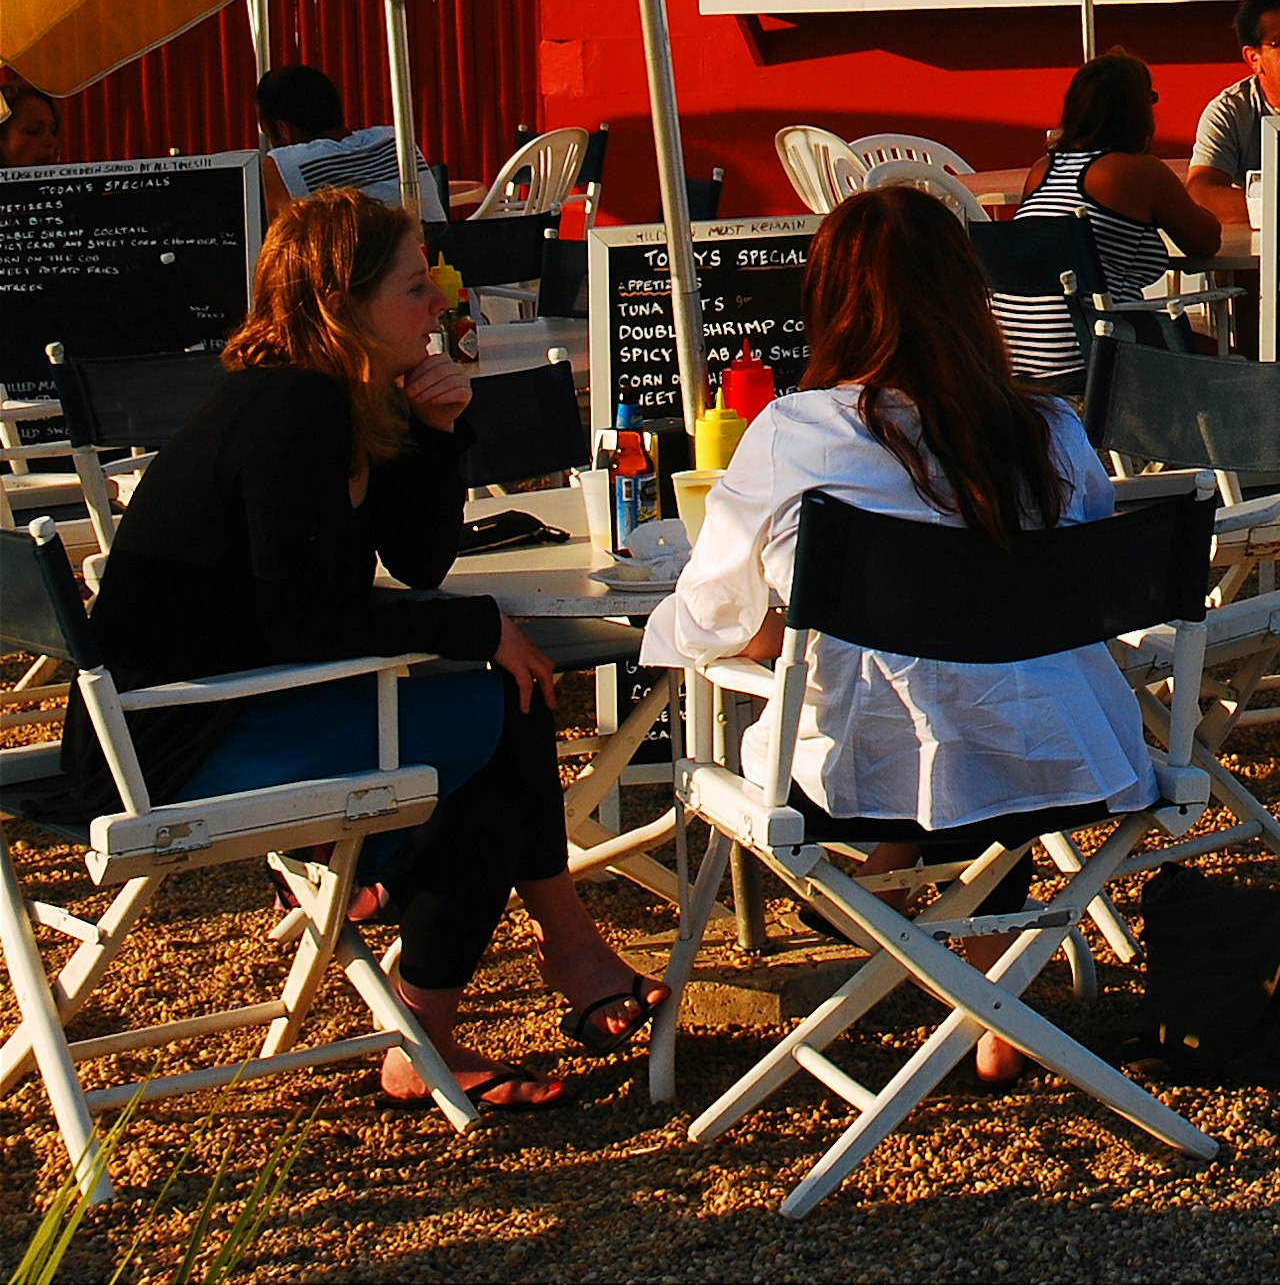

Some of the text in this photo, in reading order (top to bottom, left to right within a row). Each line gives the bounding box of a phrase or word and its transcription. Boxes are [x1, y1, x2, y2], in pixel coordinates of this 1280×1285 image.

[104, 177, 170, 191] SPECIALS
[29, 217, 63, 226] BITS
[40, 229, 84, 239] SHRIMP
[94, 226, 148, 236] COCKTAIL
[709, 224, 744, 237] MUST
[27, 241, 55, 249] CRAB
[644, 249, 722, 266] TOYS
[617, 302, 664, 317] TUNA
[619, 325, 676, 340] DOUBL
[703, 320, 775, 336] SHRIMP
[619, 346, 673, 363] SPICY
[707, 347, 730, 361] AB
[768, 345, 811, 361] SWEE
[618, 373, 663, 388] CORN
